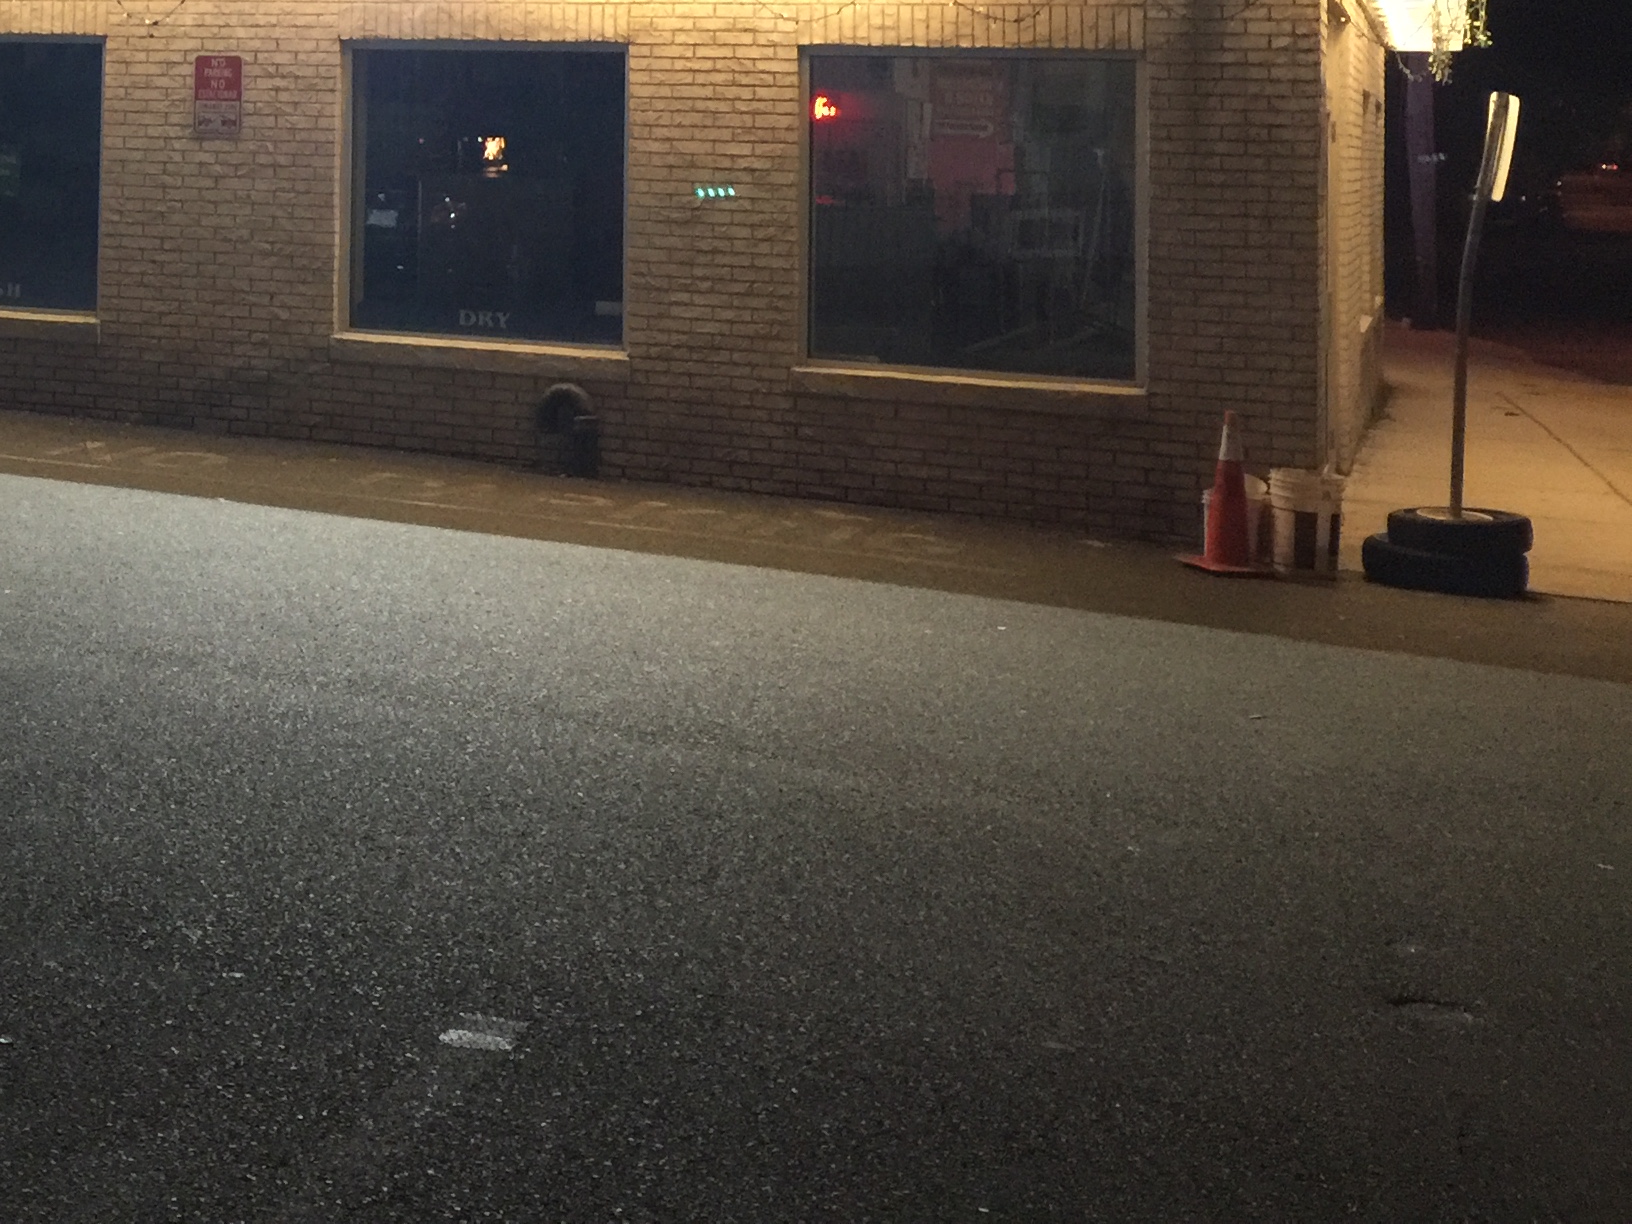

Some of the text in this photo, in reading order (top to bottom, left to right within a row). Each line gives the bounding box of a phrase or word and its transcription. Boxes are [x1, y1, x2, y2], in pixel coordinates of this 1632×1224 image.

[211, 58, 226, 67] NO
[204, 68, 232, 77] PARKING
[211, 79, 225, 89] NO
[459, 309, 510, 328] DRY
